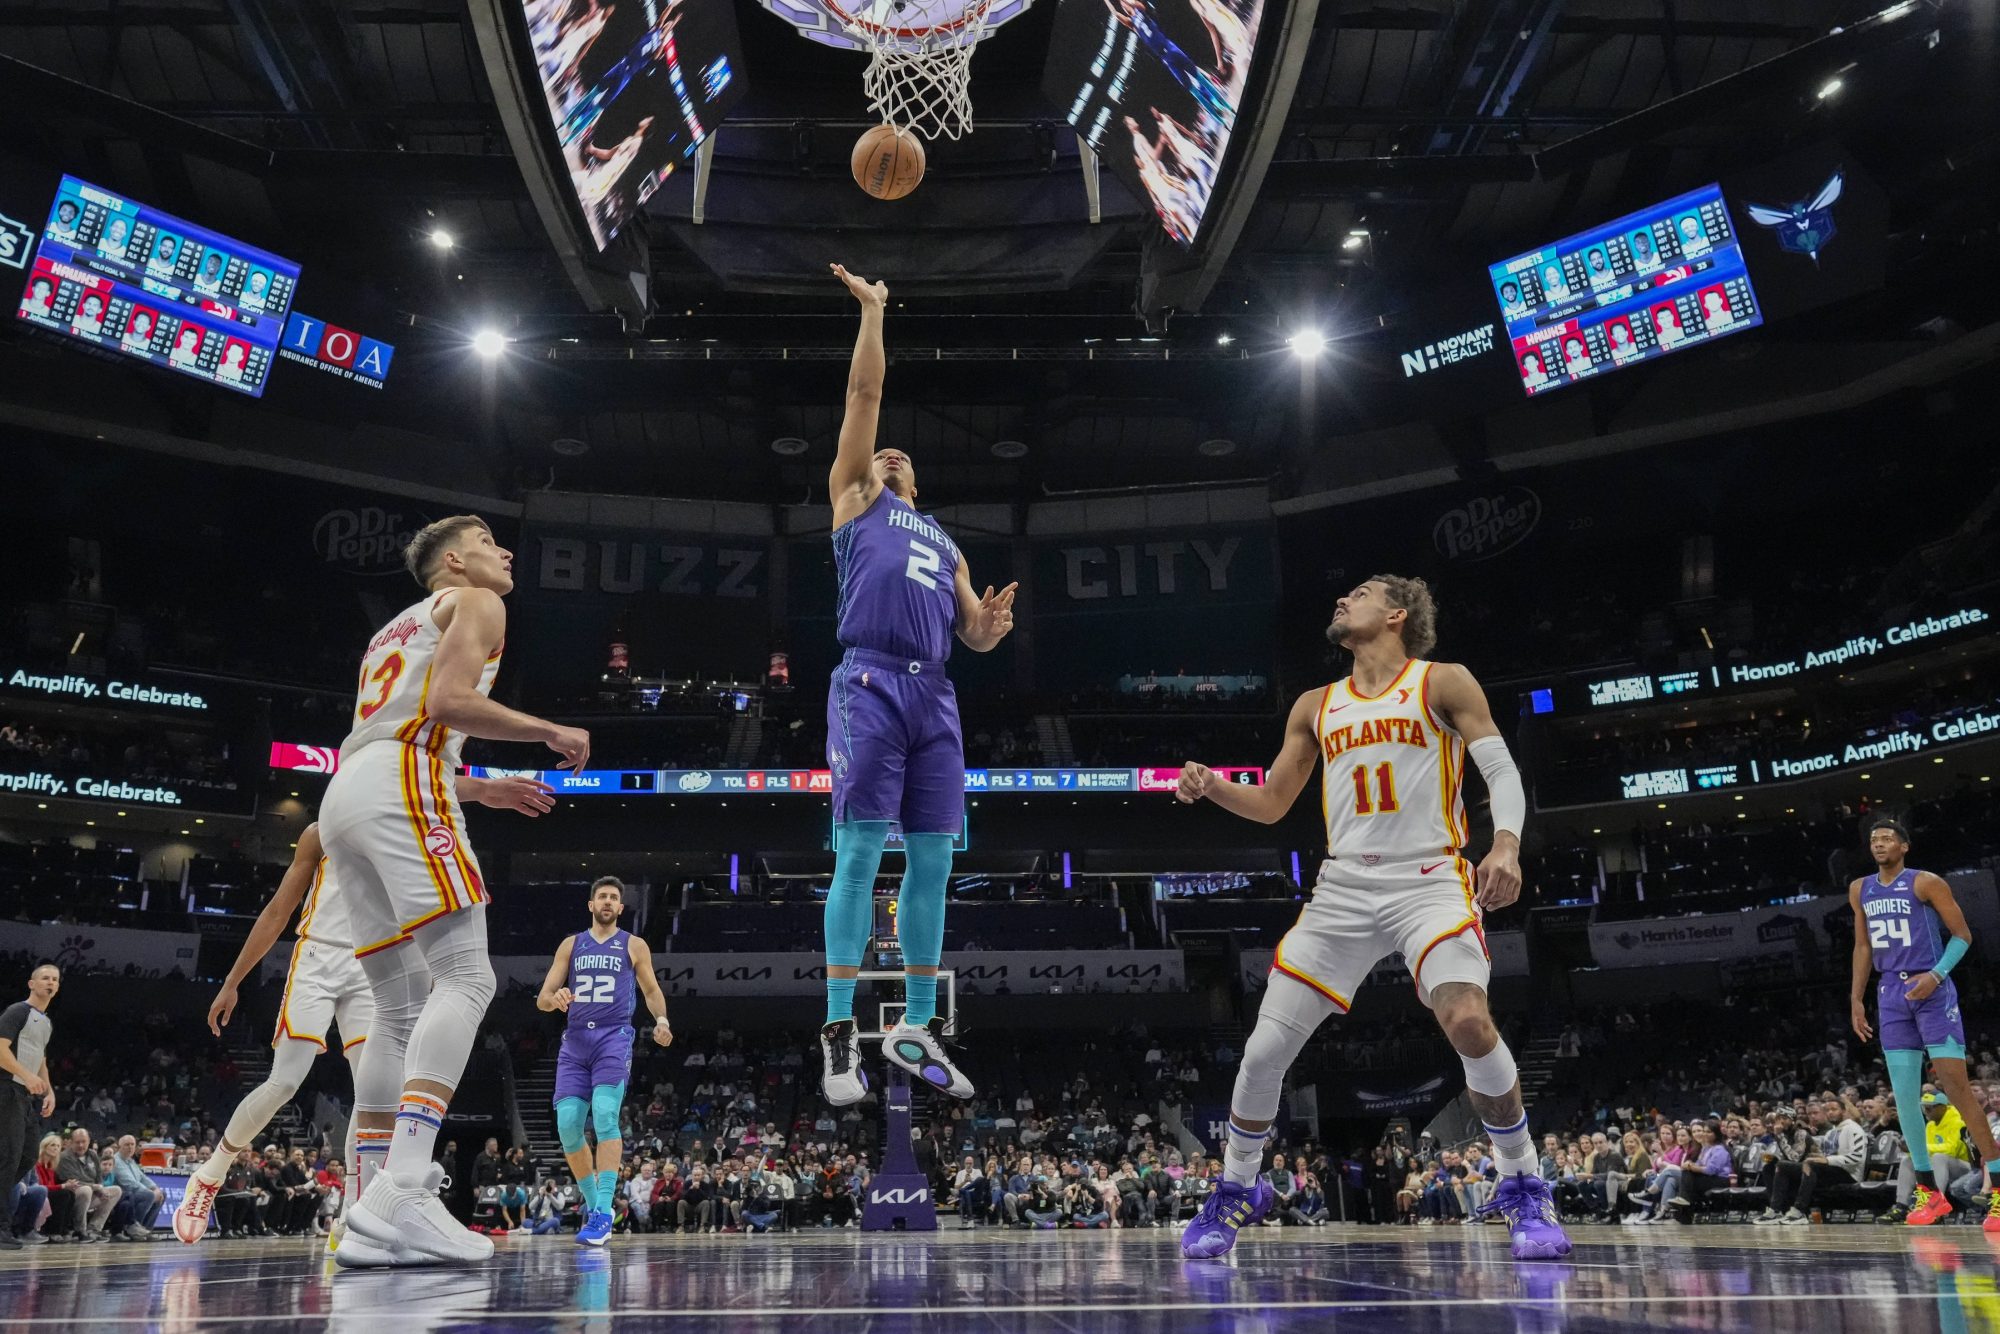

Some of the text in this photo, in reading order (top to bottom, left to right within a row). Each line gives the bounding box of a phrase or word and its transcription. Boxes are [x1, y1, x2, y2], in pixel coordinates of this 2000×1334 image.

[90, 262, 104, 270] FIELD
[104, 266, 119, 275] GOAL
[105, 252, 135, 269] Williams
[51, 262, 100, 288] HAWKS
[1556, 292, 1584, 305] Williams
[28, 312, 59, 328] Johnson
[1549, 312, 1562, 320] FIELD
[1563, 306, 1576, 315] GOAL
[80, 330, 102, 342] Young
[1437, 323, 1493, 353] NOVANT
[1526, 323, 1567, 345] HAWKS
[1670, 332, 1710, 349] Bogdanovic
[128, 346, 152, 359] Hunter
[1441, 338, 1493, 366] HEALTH
[1623, 352, 1646, 364] Hunter
[176, 361, 214, 380] Bogdanovic
[280, 349, 383, 390] INSURANCE OFFICE OF AMERICA
[1579, 368, 1598, 378] Young
[1535, 380, 1561, 392] Johnson
[1467, 494, 1506, 526] Dr
[360, 507, 403, 537] Dr
[1438, 500, 1532, 559] Pepper
[318, 510, 413, 567] Peppe
[886, 509, 958, 559] HORNETS
[537, 537, 764, 598] BUZZ
[906, 539, 940, 590] 2
[1061, 538, 1242, 599] CITY
[1731, 608, 1988, 682] Honor. Amplify. Celebrate.
[10, 670, 208, 709] Amplify. Celebrate.
[1685, 680, 1698, 690] NC
[1323, 718, 1428, 765] ATLANTA
[1772, 753, 1838, 778] Honor.
[1844, 731, 1928, 763] Amplify.
[564, 775, 640, 788] STEALS 1
[722, 777, 746, 787] TOL
[750, 777, 758, 787] 6
[767, 777, 788, 787] FLS
[794, 777, 800, 786] 1
[992, 776, 1012, 786] FLS
[1018, 775, 1027, 786] 2
[1032, 776, 1055, 786] TOL
[1062, 775, 1071, 786] 7
[1240, 772, 1249, 784] 6
[1722, 774, 1737, 784] NC
[76, 777, 182, 804] Celebrate.
[1352, 761, 1400, 816] 11
[1862, 899, 1912, 918] HORNETS
[1642, 926, 1734, 942] Harris Teeter
[1869, 919, 1912, 948] 24
[575, 954, 622, 972] HORNETS
[1030, 964, 1084, 978] KIA
[1106, 964, 1162, 978] KIA
[716, 966, 772, 980] KIA
[954, 966, 1008, 978] KIA
[574, 975, 616, 1003] 22
[1365, 1094, 1432, 1109] HORNETS
[872, 1188, 928, 1204] KIA
